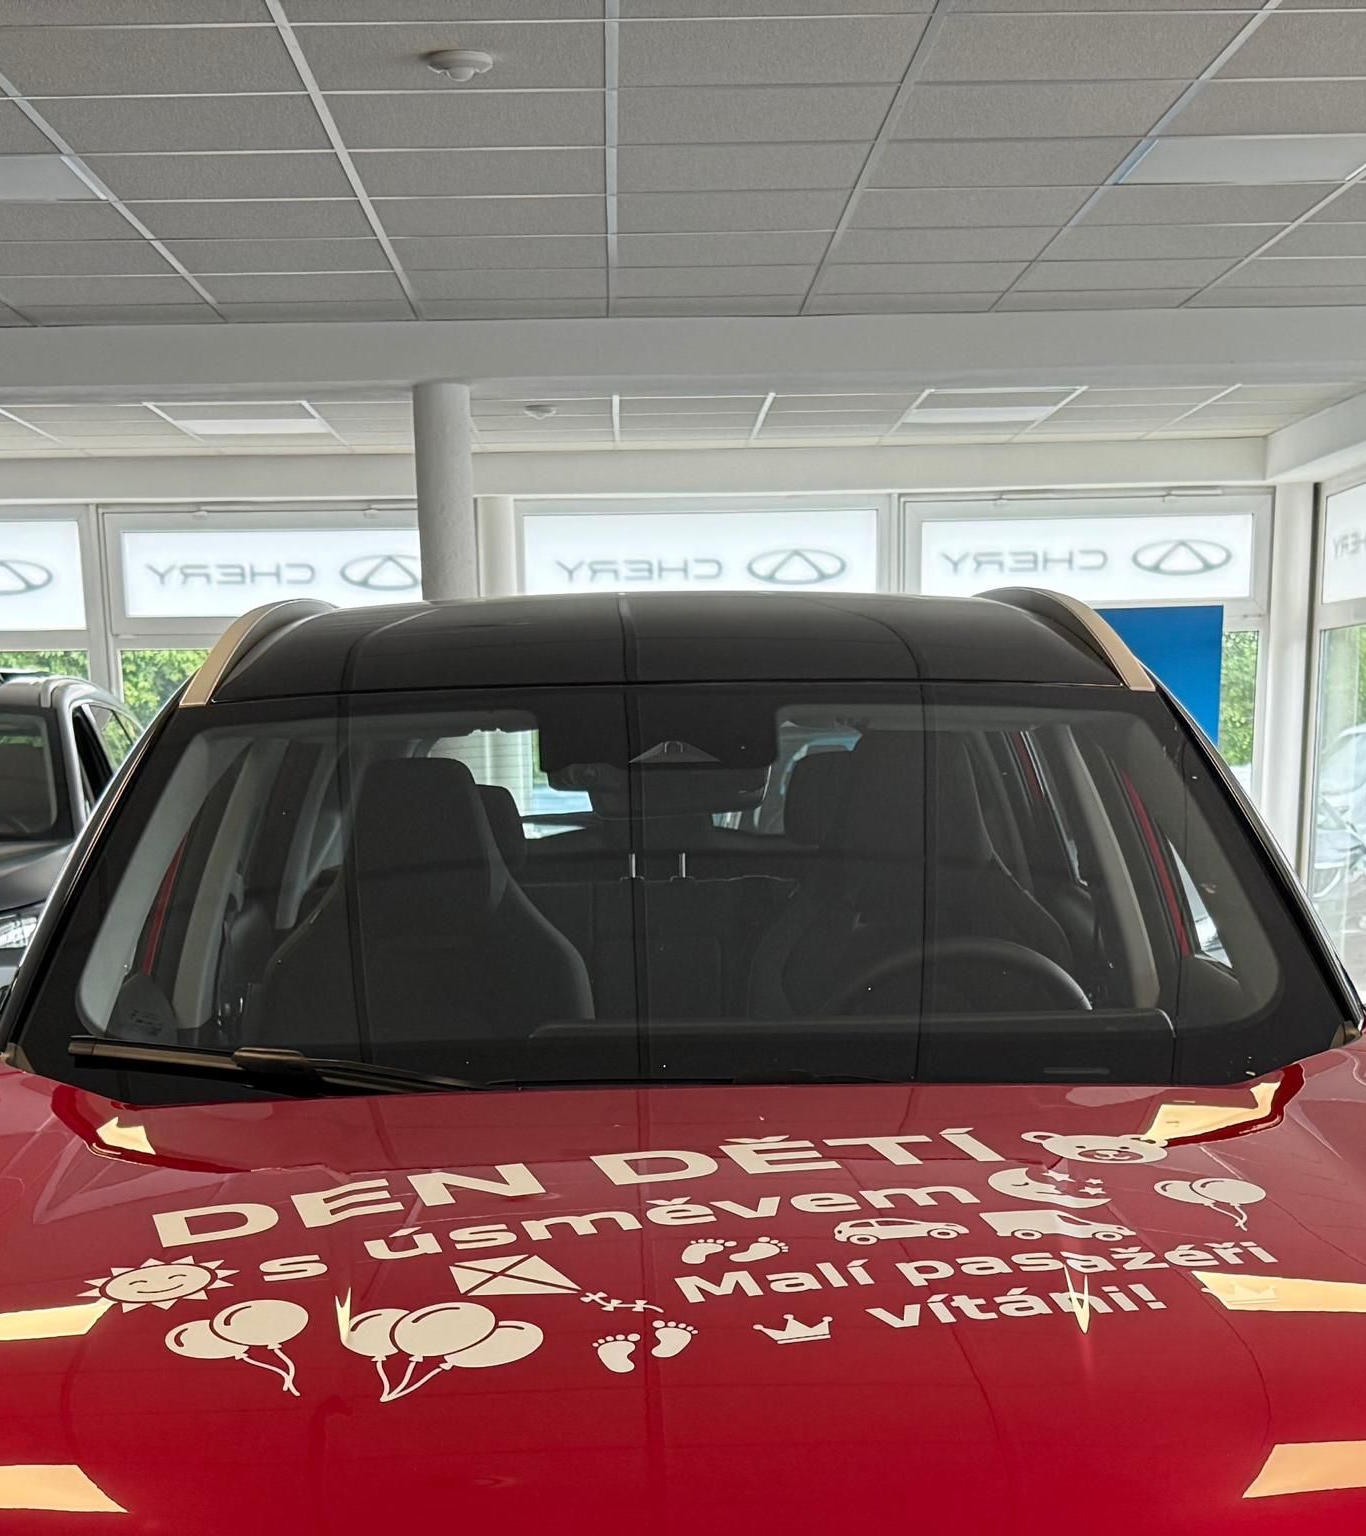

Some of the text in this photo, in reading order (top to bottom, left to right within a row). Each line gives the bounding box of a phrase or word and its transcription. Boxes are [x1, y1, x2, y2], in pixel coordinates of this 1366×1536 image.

[152, 1128, 1005, 1248] DEN DĚTÍ
[259, 1186, 981, 1281] s úsměvem
[674, 1241, 1278, 1303] Malí pasažéři
[865, 1284, 1167, 1328] vítáni!
